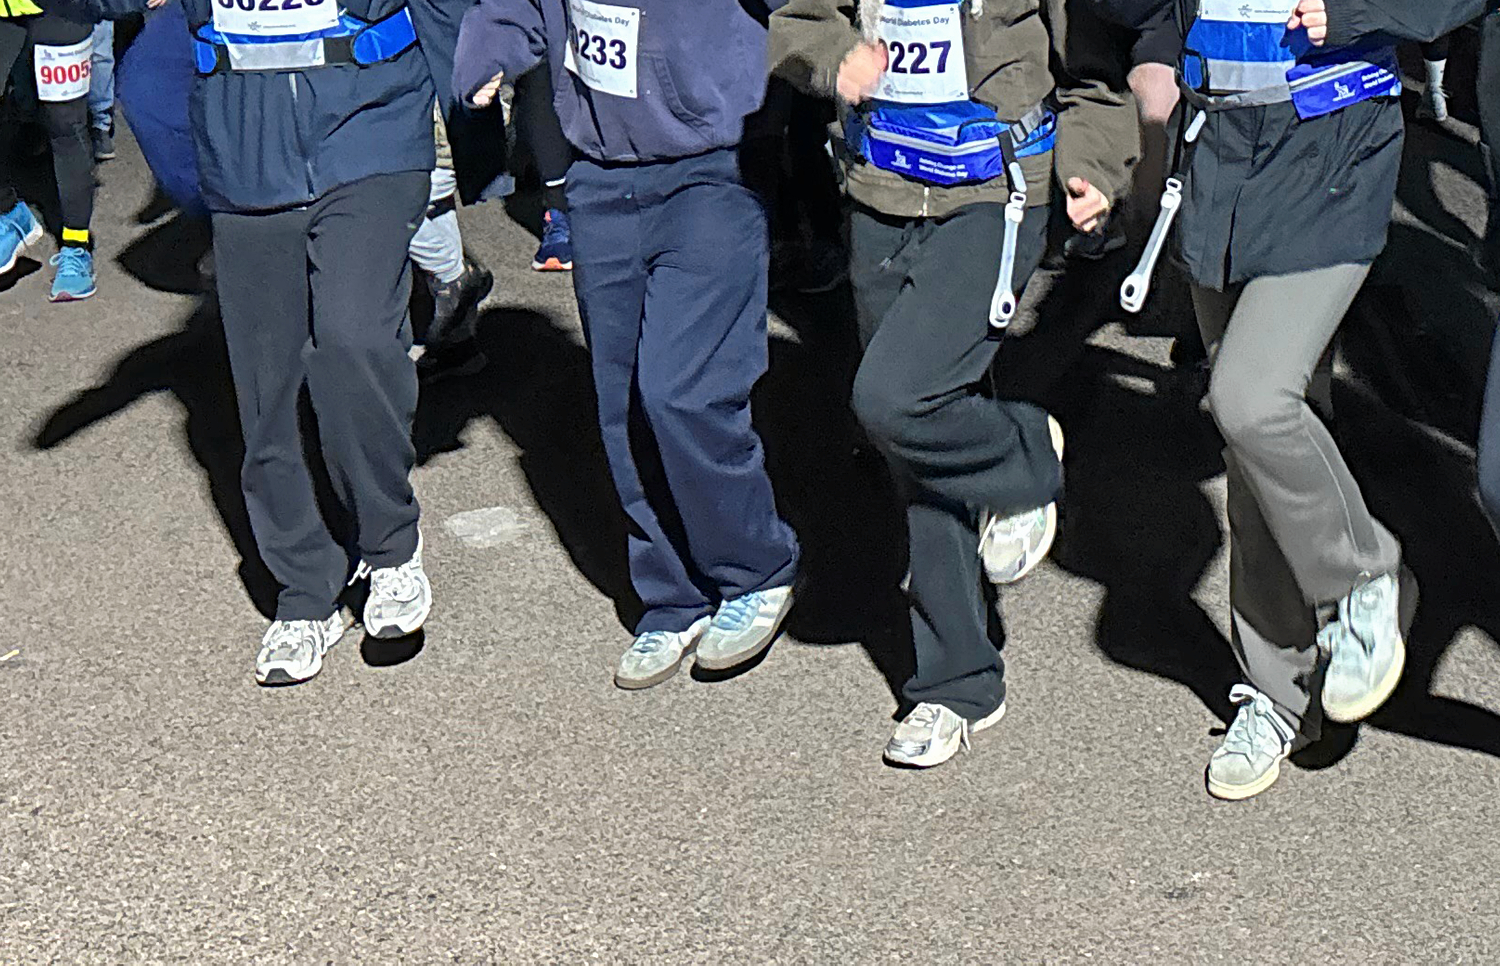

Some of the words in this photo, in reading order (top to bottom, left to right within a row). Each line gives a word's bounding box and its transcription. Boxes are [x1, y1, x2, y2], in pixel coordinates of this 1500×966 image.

[614, 16, 630, 27] Day
[933, 17, 950, 25] Day
[878, 37, 952, 74] 227
[40, 59, 92, 85] 9005
